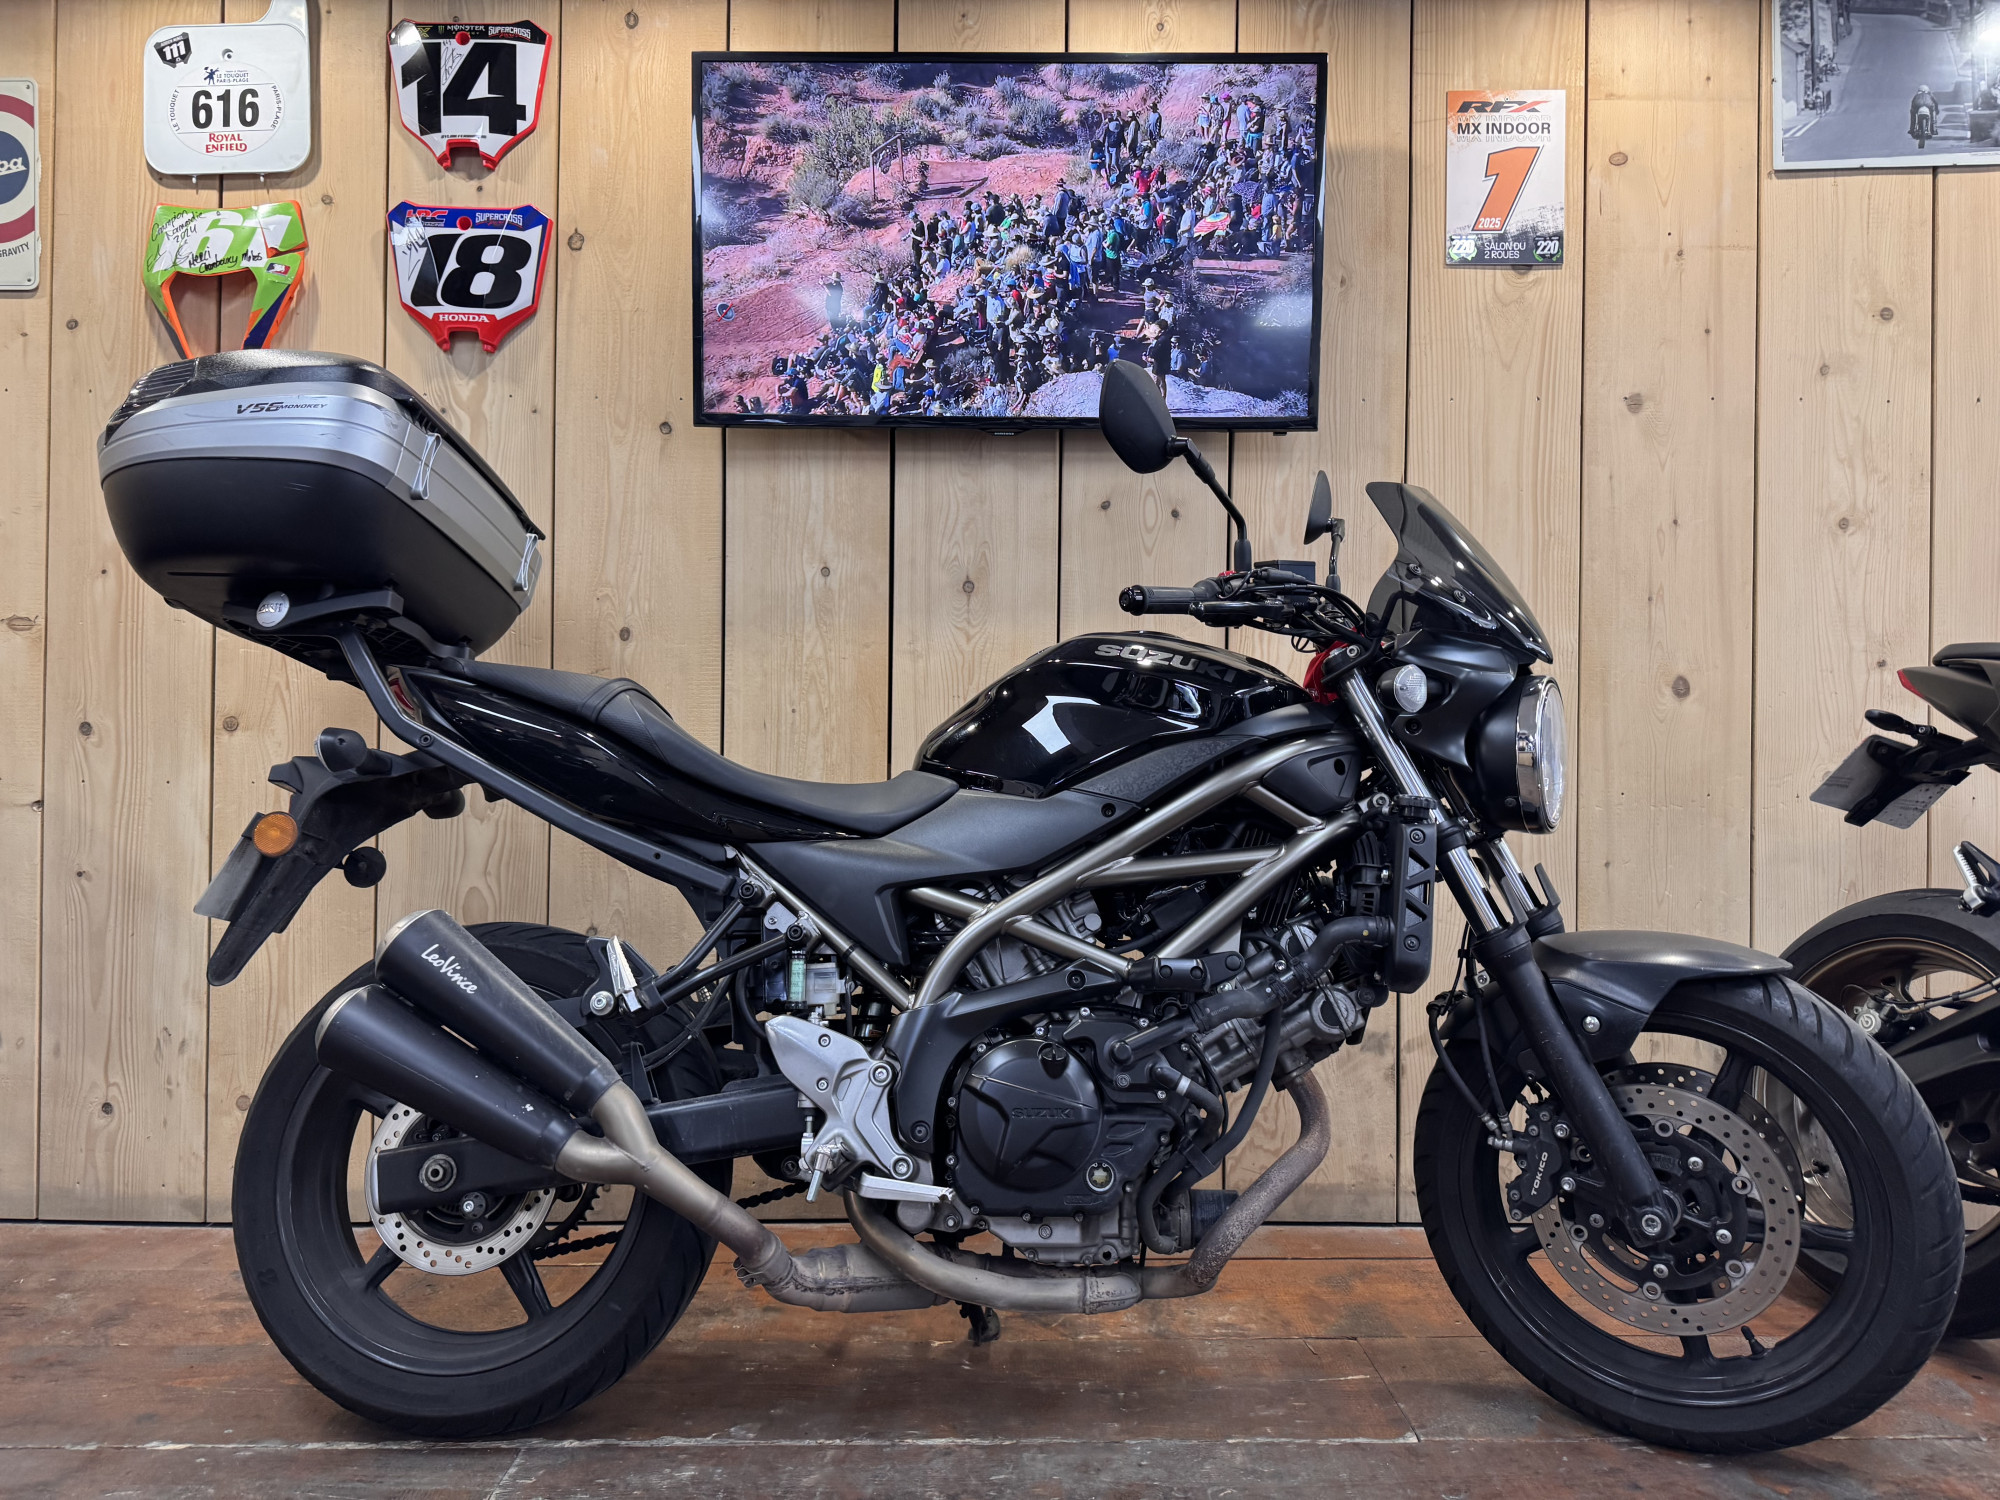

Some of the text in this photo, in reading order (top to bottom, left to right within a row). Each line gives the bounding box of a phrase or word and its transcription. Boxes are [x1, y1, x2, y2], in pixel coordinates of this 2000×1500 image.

[488, 26, 531, 39] SUPERCROSS
[162, 40, 186, 61] 111
[401, 42, 526, 136] 14
[169, 89, 180, 132] LE TOUQUET
[191, 88, 260, 129] 616
[1456, 100, 1551, 113] RFX
[1457, 122, 1551, 134] MX INDOOR
[208, 133, 243, 143] ROYAL
[205, 143, 247, 154] ENFIELD
[1471, 146, 1541, 232] 1
[476, 212, 523, 225] SUPERCROSS
[1478, 217, 1501, 228] 2025
[1452, 239, 1475, 254] 220
[1484, 242, 1526, 251] SALON DU
[1535, 240, 1559, 254] 220
[1484, 250, 1520, 259] 2 ROUES
[410, 233, 532, 309] 18
[438, 314, 490, 323] HONDA
[1094, 644, 1237, 683] SUZUKI
[420, 943, 478, 994] LeoVince
[1530, 1151, 1549, 1196] TOKICO
